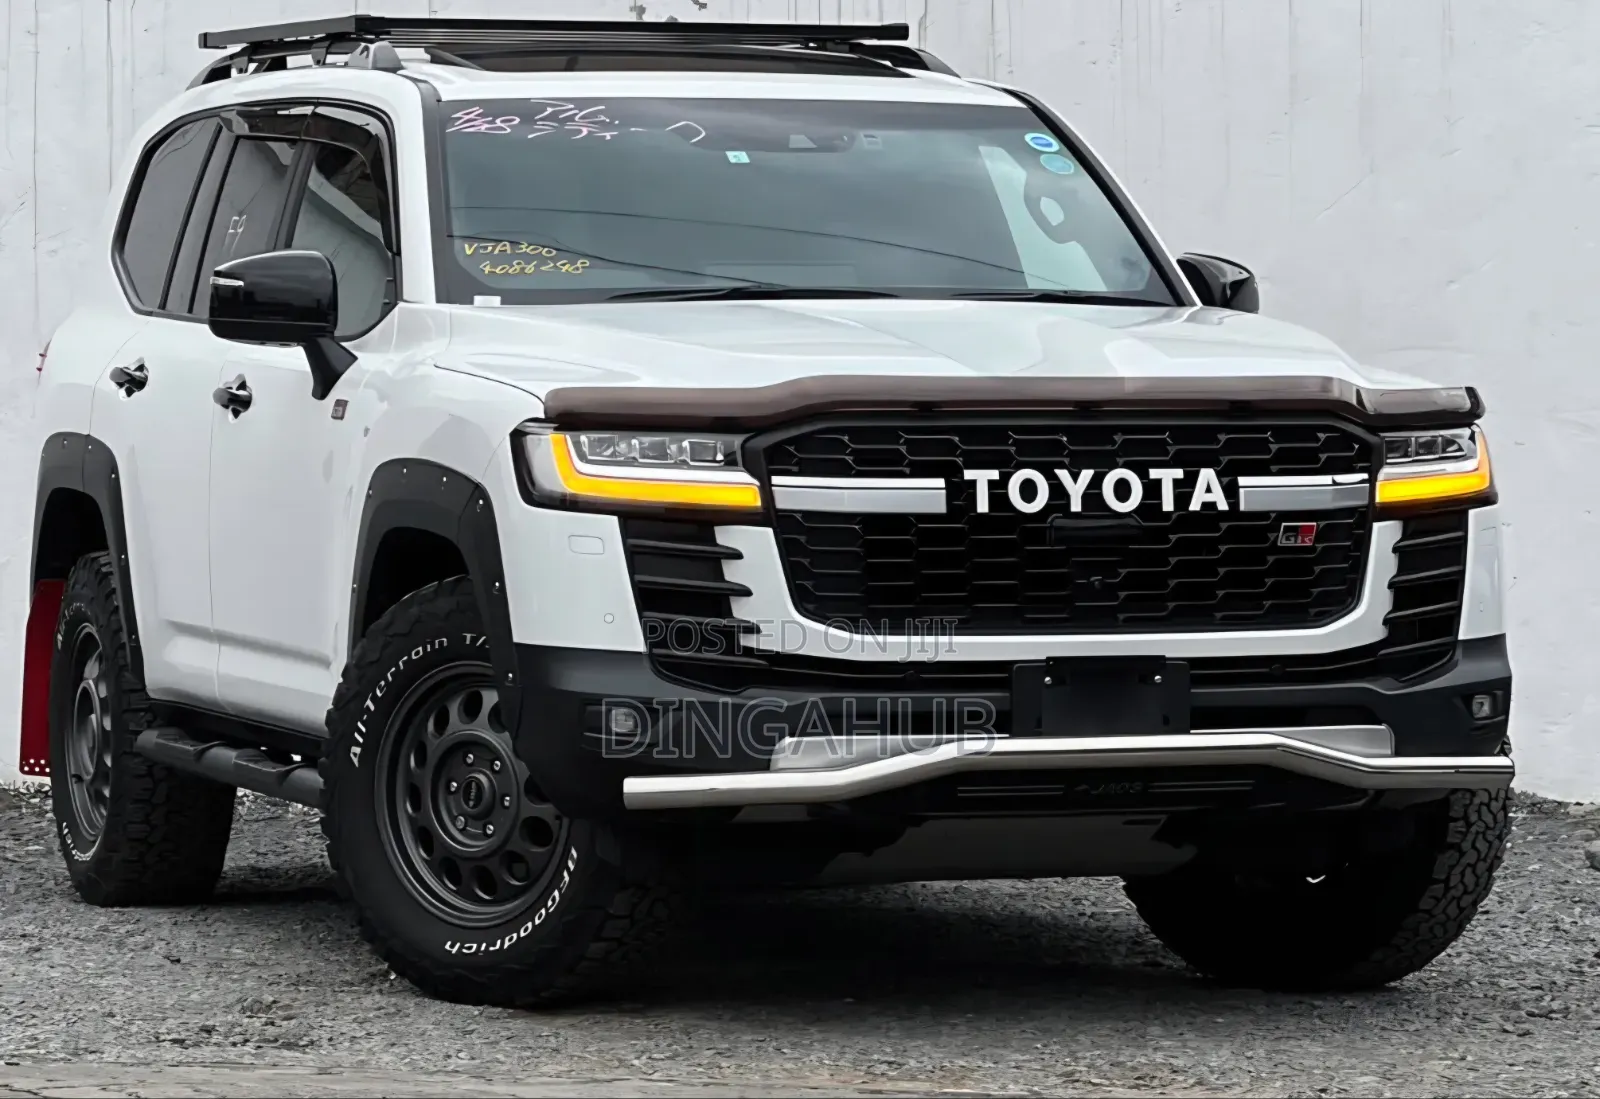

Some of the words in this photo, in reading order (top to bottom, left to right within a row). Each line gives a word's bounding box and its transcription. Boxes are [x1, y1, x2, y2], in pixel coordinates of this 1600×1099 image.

[479, 259, 590, 275] 4086248
[963, 468, 1229, 514] TOYOTA
[350, 636, 449, 768] All-Terrain
[461, 632, 491, 649] T/
[444, 845, 578, 956] BFGoodrich
